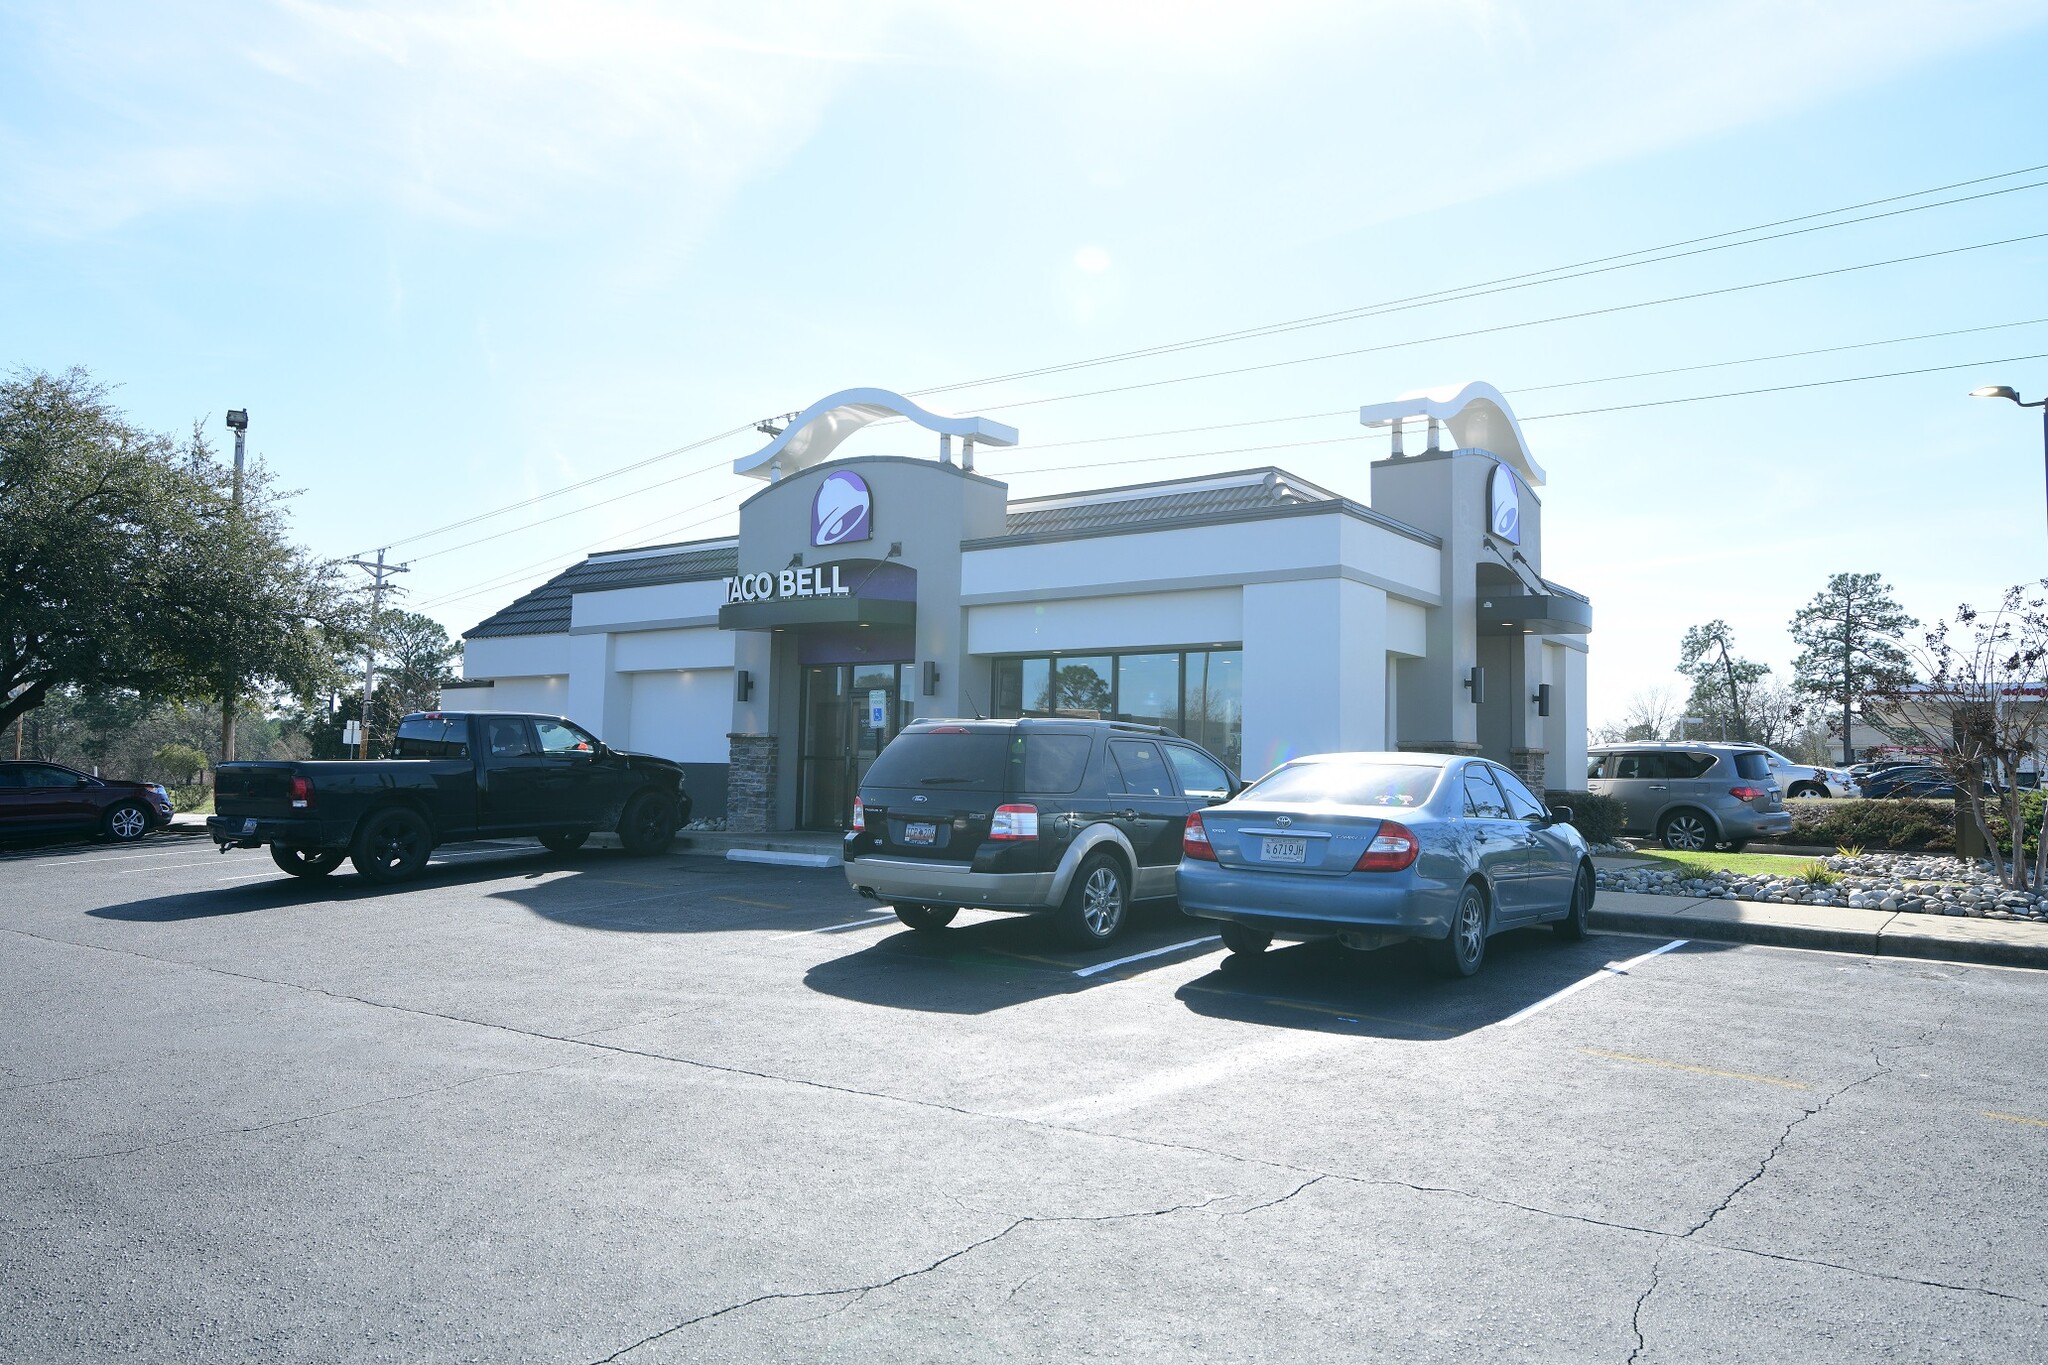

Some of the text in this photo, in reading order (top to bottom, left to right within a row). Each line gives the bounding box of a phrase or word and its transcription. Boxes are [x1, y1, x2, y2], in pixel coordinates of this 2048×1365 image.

[722, 566, 850, 603] TACO BELL
[1272, 843, 1304, 856] 6719JH
